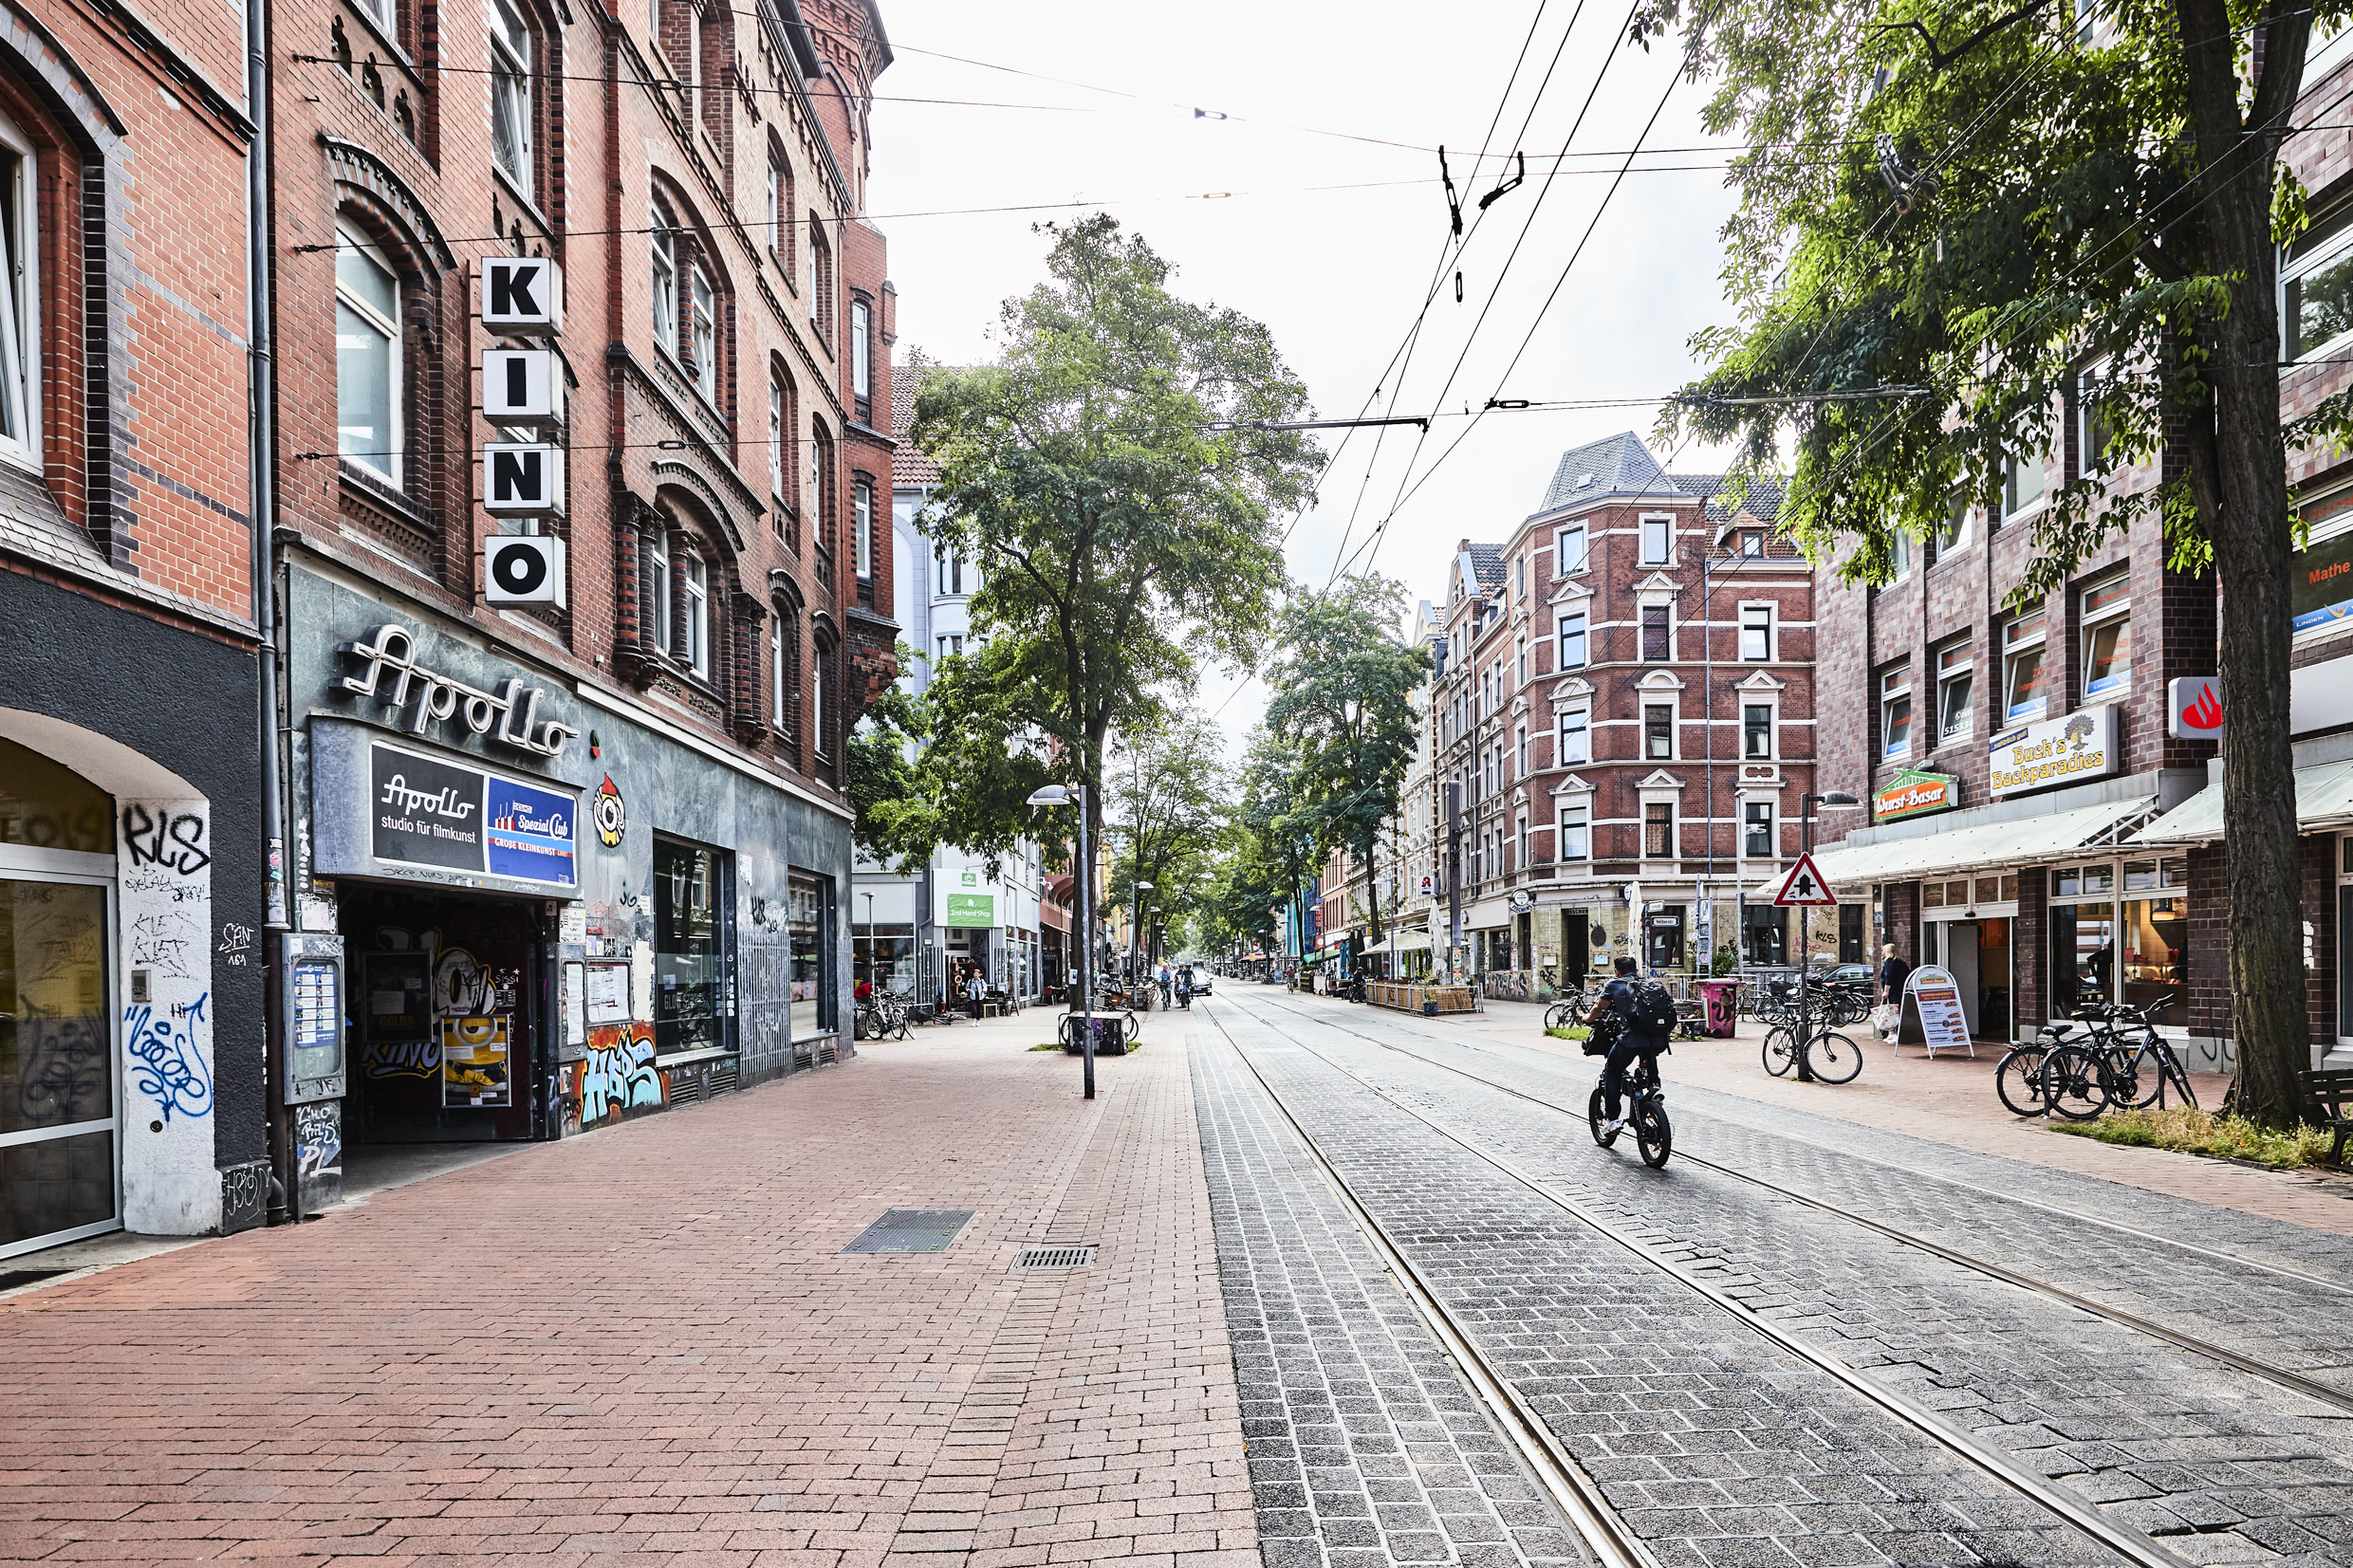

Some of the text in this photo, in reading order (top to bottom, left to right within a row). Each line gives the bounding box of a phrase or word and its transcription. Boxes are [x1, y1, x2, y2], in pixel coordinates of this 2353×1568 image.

[491, 265, 547, 596] KINO
[2308, 562, 2351, 584] Mathe
[2296, 616, 2324, 628] LINDEN
[337, 624, 580, 758] Apollo
[2012, 736, 2066, 766] Buck's
[1992, 750, 2104, 789] Backparadies
[380, 773, 475, 820] Apollo
[1876, 786, 1945, 814] Wurst-Basar
[380, 815, 476, 843] studio für filmkunst
[517, 813, 568, 840] Spezial Club
[517, 841, 556, 857] KLEINKUNST
[976, 910, 991, 918] Shop
[494, 974, 519, 985] SISSI
